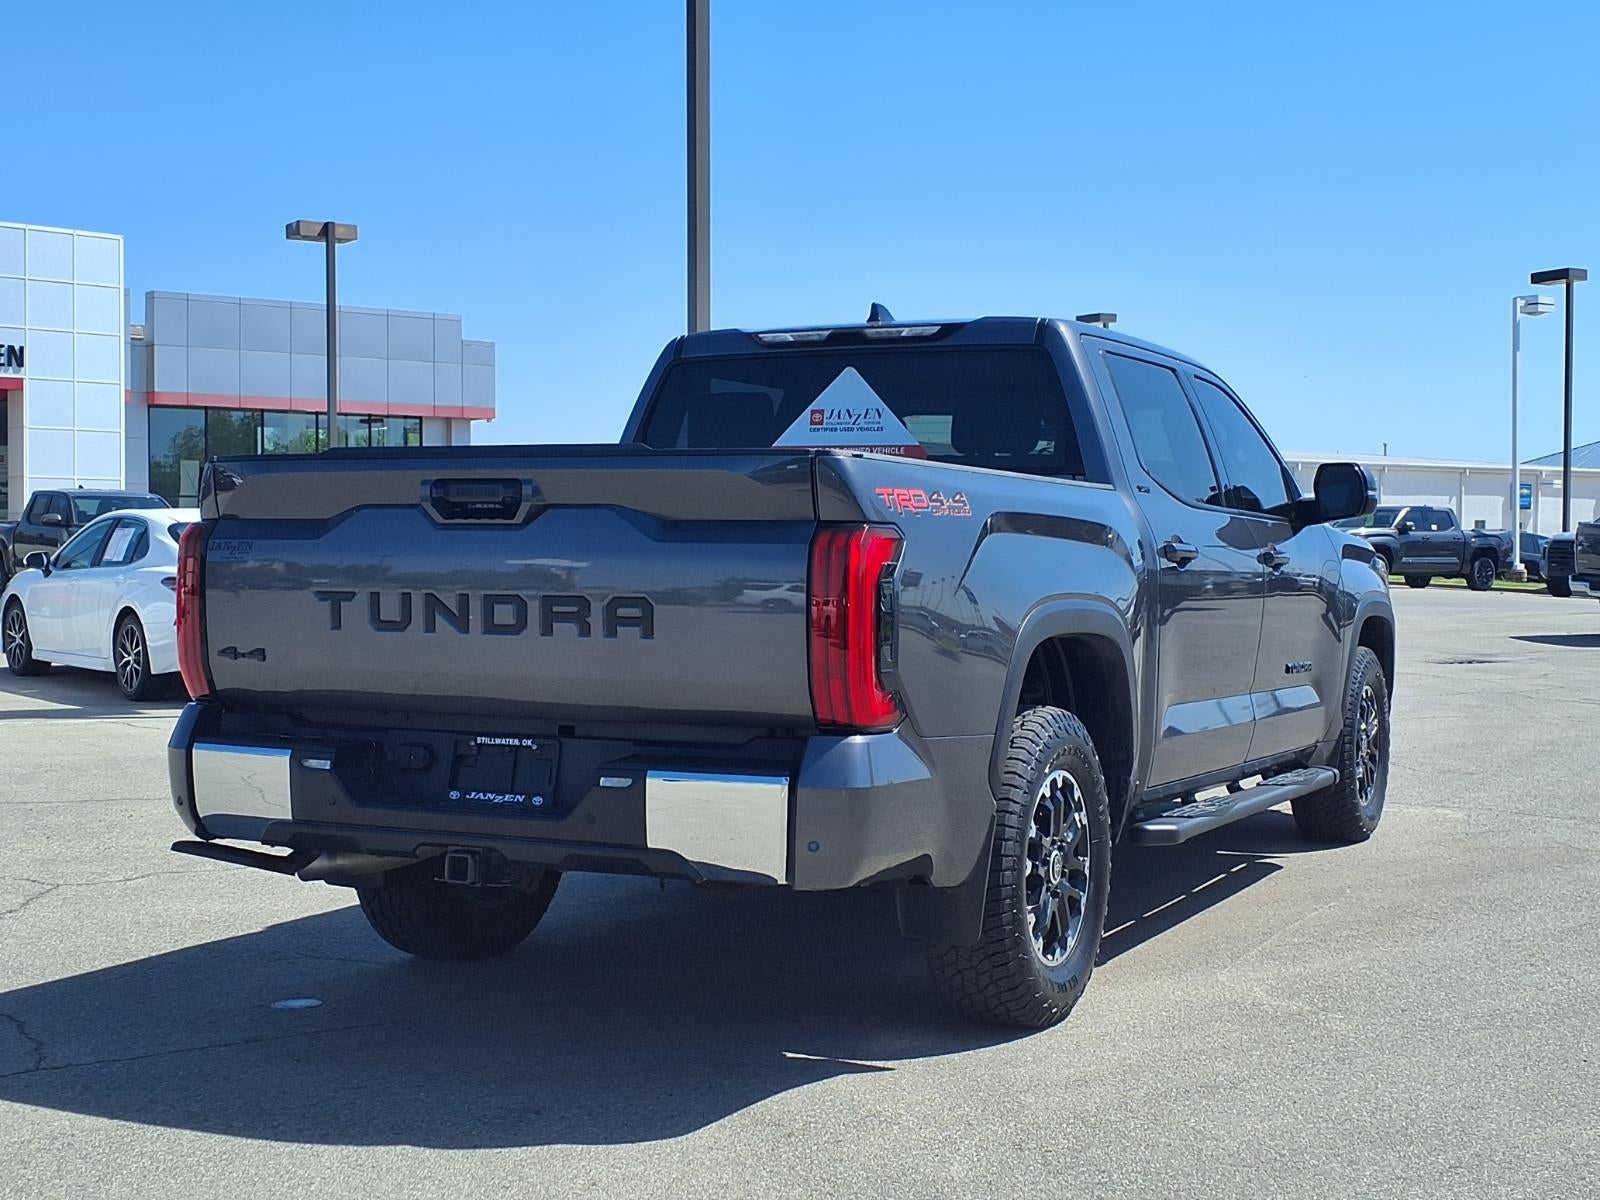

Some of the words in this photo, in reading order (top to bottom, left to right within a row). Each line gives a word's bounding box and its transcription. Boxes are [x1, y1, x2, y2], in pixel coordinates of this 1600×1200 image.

[825, 408, 885, 425] JANZEN
[872, 447, 905, 455] VEHICLE
[875, 488, 929, 514] TRD
[208, 541, 254, 555] JANZEN
[312, 589, 656, 640] TUNDRA
[465, 791, 526, 803] JANZEN
